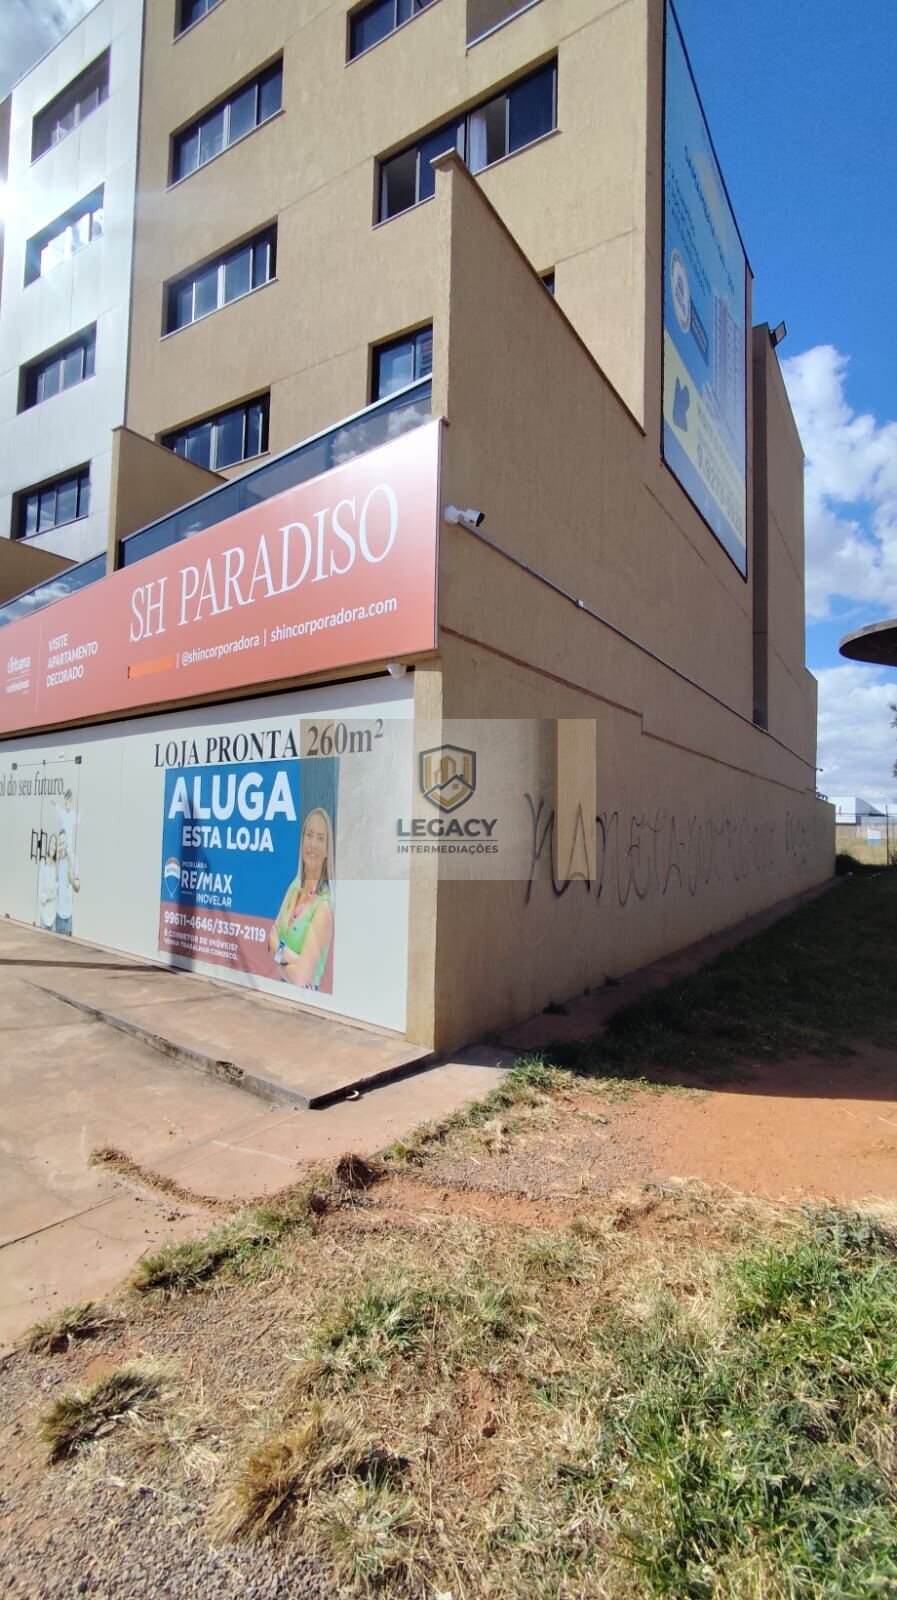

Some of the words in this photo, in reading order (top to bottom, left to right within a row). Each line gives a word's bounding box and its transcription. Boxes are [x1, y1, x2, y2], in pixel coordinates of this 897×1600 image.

[129, 576, 168, 643] SH
[177, 483, 398, 626] PARADISO
[48, 633, 69, 651] VISITE
[181, 634, 260, 666] @shincorporadora
[270, 597, 398, 643] shincorporadora.com
[47, 641, 98, 669] APARTAMENTO
[46, 664, 84, 688] DECORADO
[154, 739, 199, 769] LOJA
[206, 728, 298, 764] PRONTA
[7, 774, 18, 797] do
[168, 771, 297, 821] ALUGA
[182, 826, 222, 849] ESTA
[226, 827, 275, 853] LOJA
[181, 869, 233, 895] RE/MAX
[196, 893, 233, 908] INOVELAR
